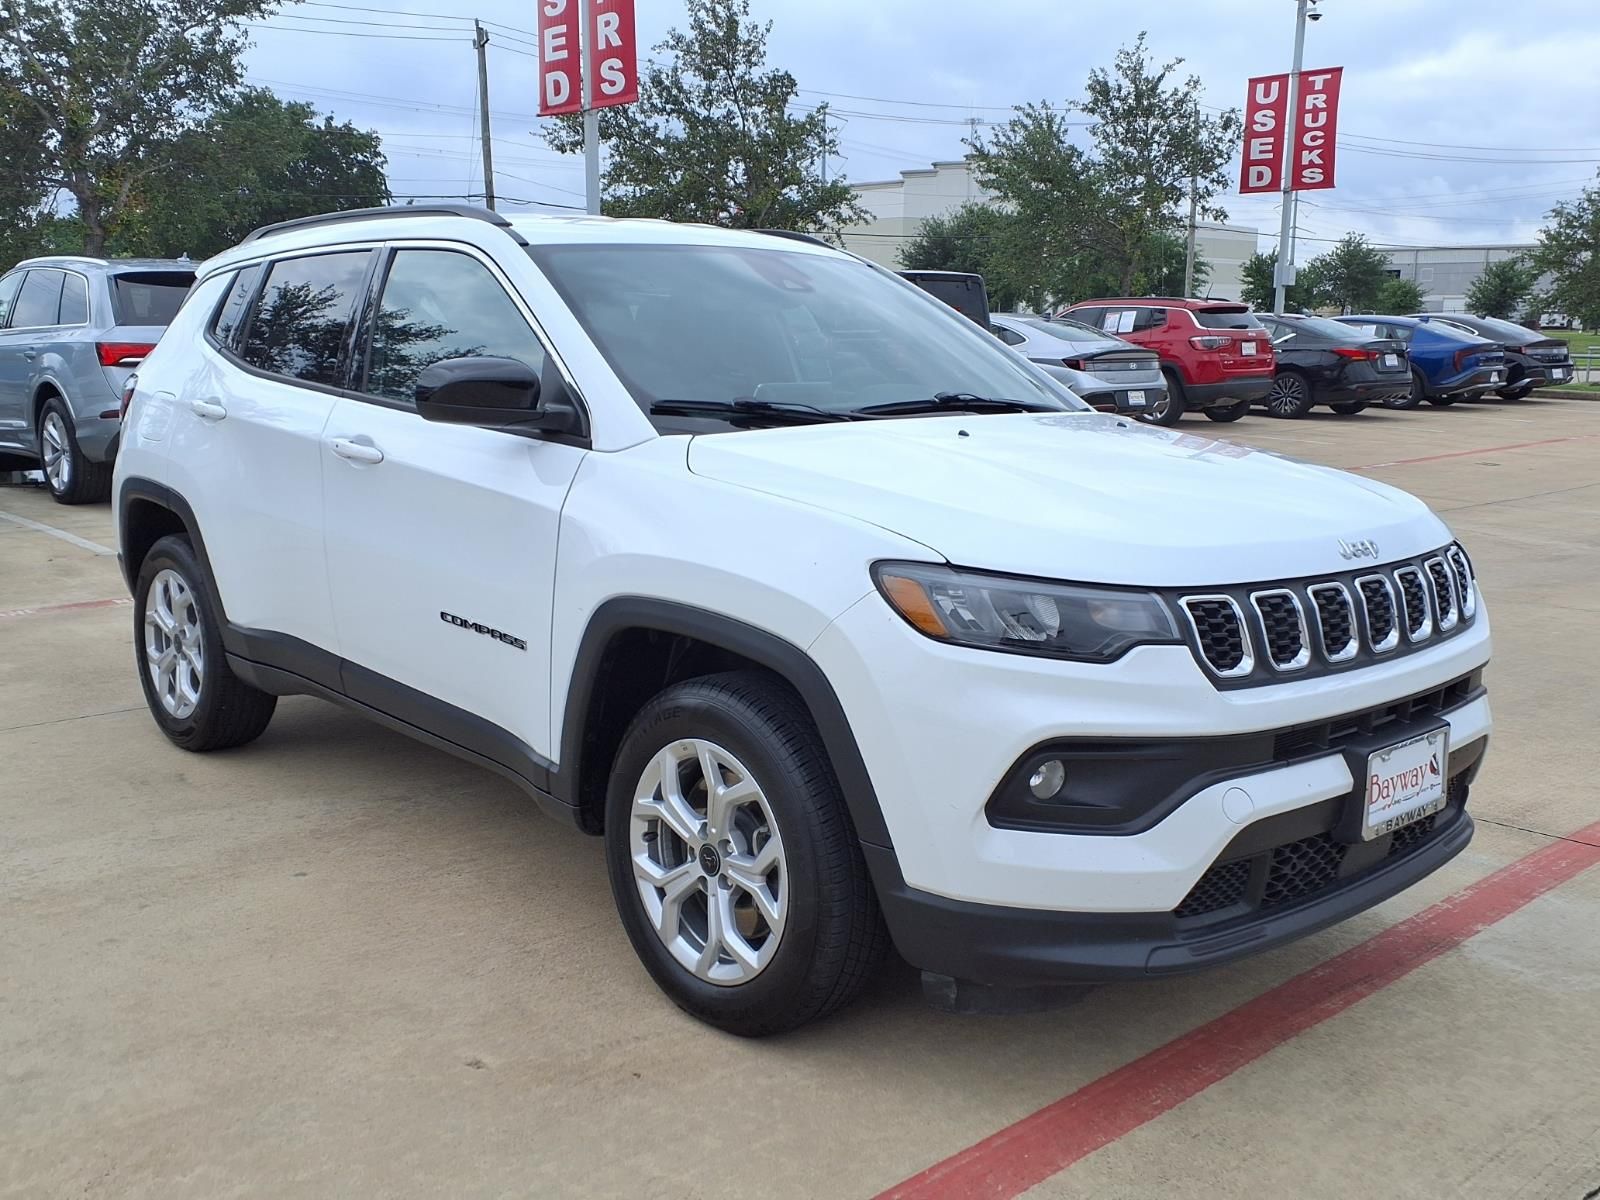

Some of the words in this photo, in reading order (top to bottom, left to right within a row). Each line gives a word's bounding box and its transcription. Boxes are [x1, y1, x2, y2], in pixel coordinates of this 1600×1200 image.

[597, 0, 626, 95] RS
[1248, 81, 1279, 187] USED
[1301, 74, 1331, 183] TRUCKS
[1338, 538, 1379, 560] Jeep
[440, 611, 527, 651] COMPASS
[1369, 763, 1428, 807] Bayway
[1386, 805, 1426, 831] BAYWAY
